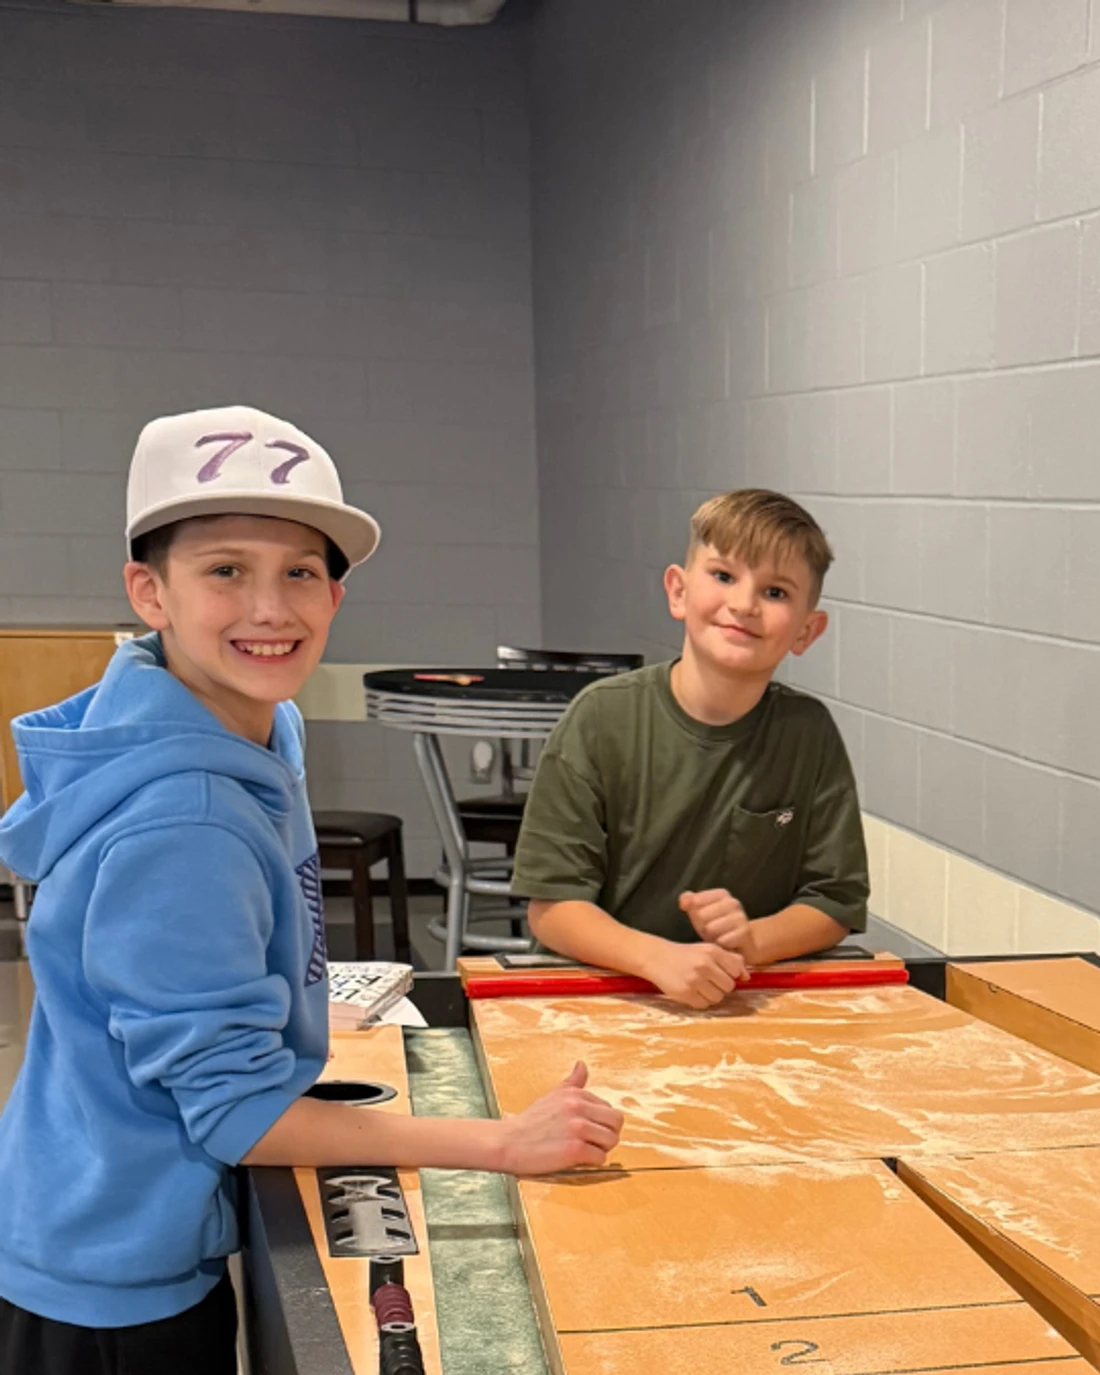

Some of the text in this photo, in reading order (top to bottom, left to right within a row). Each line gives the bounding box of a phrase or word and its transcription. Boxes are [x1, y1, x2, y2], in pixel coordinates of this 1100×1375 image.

[195, 432, 311, 484] 77
[730, 1286, 767, 1307] 1
[770, 1339, 830, 1365] 2
